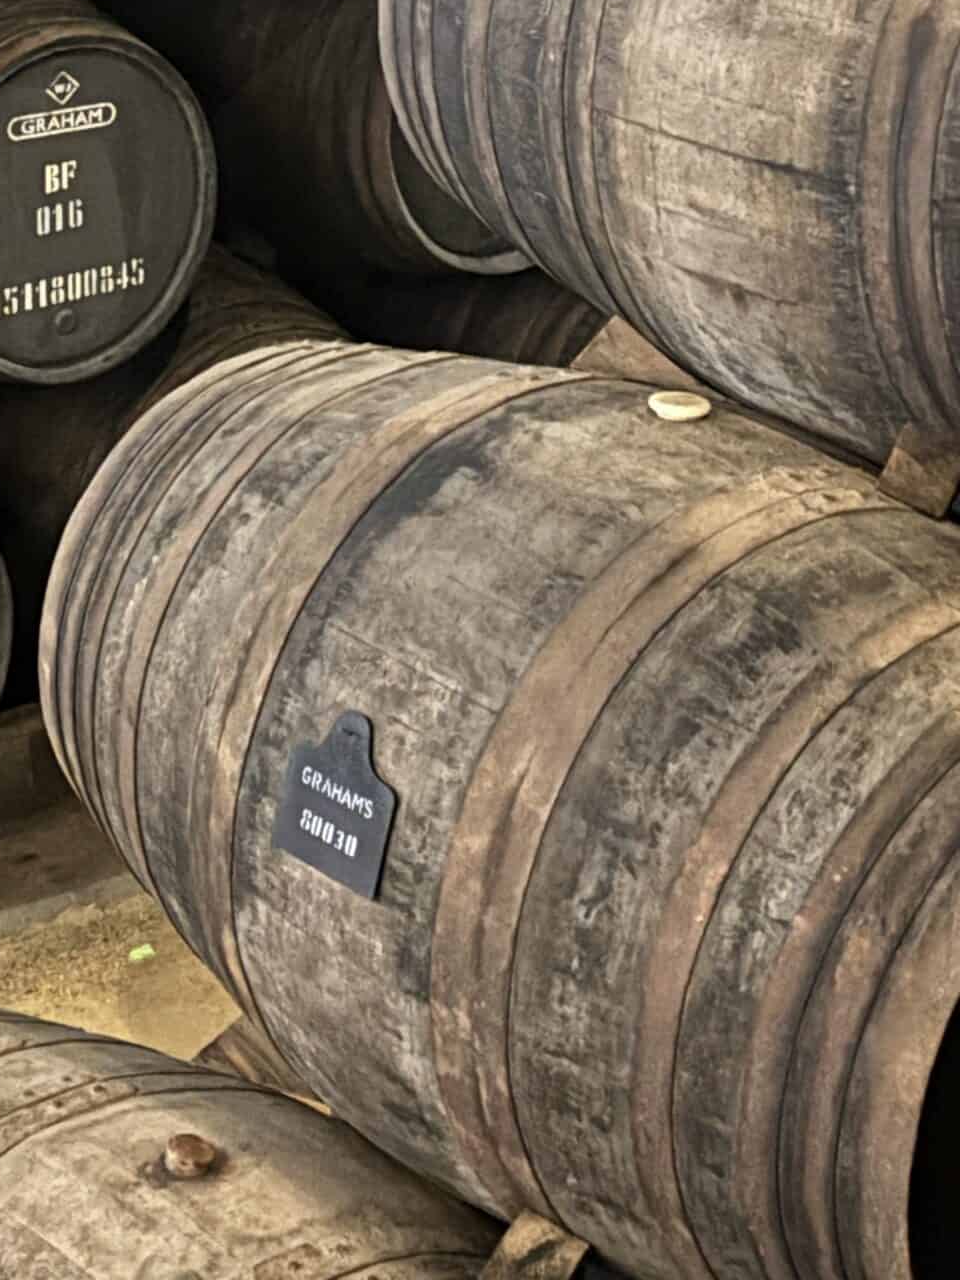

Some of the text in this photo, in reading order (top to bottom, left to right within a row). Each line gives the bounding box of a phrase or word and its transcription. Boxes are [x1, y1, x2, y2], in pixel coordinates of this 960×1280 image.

[20, 107, 104, 135] GRAHAM
[44, 159, 77, 195] BF
[36, 199, 83, 236] 016
[300, 808, 358, 858] 80030
